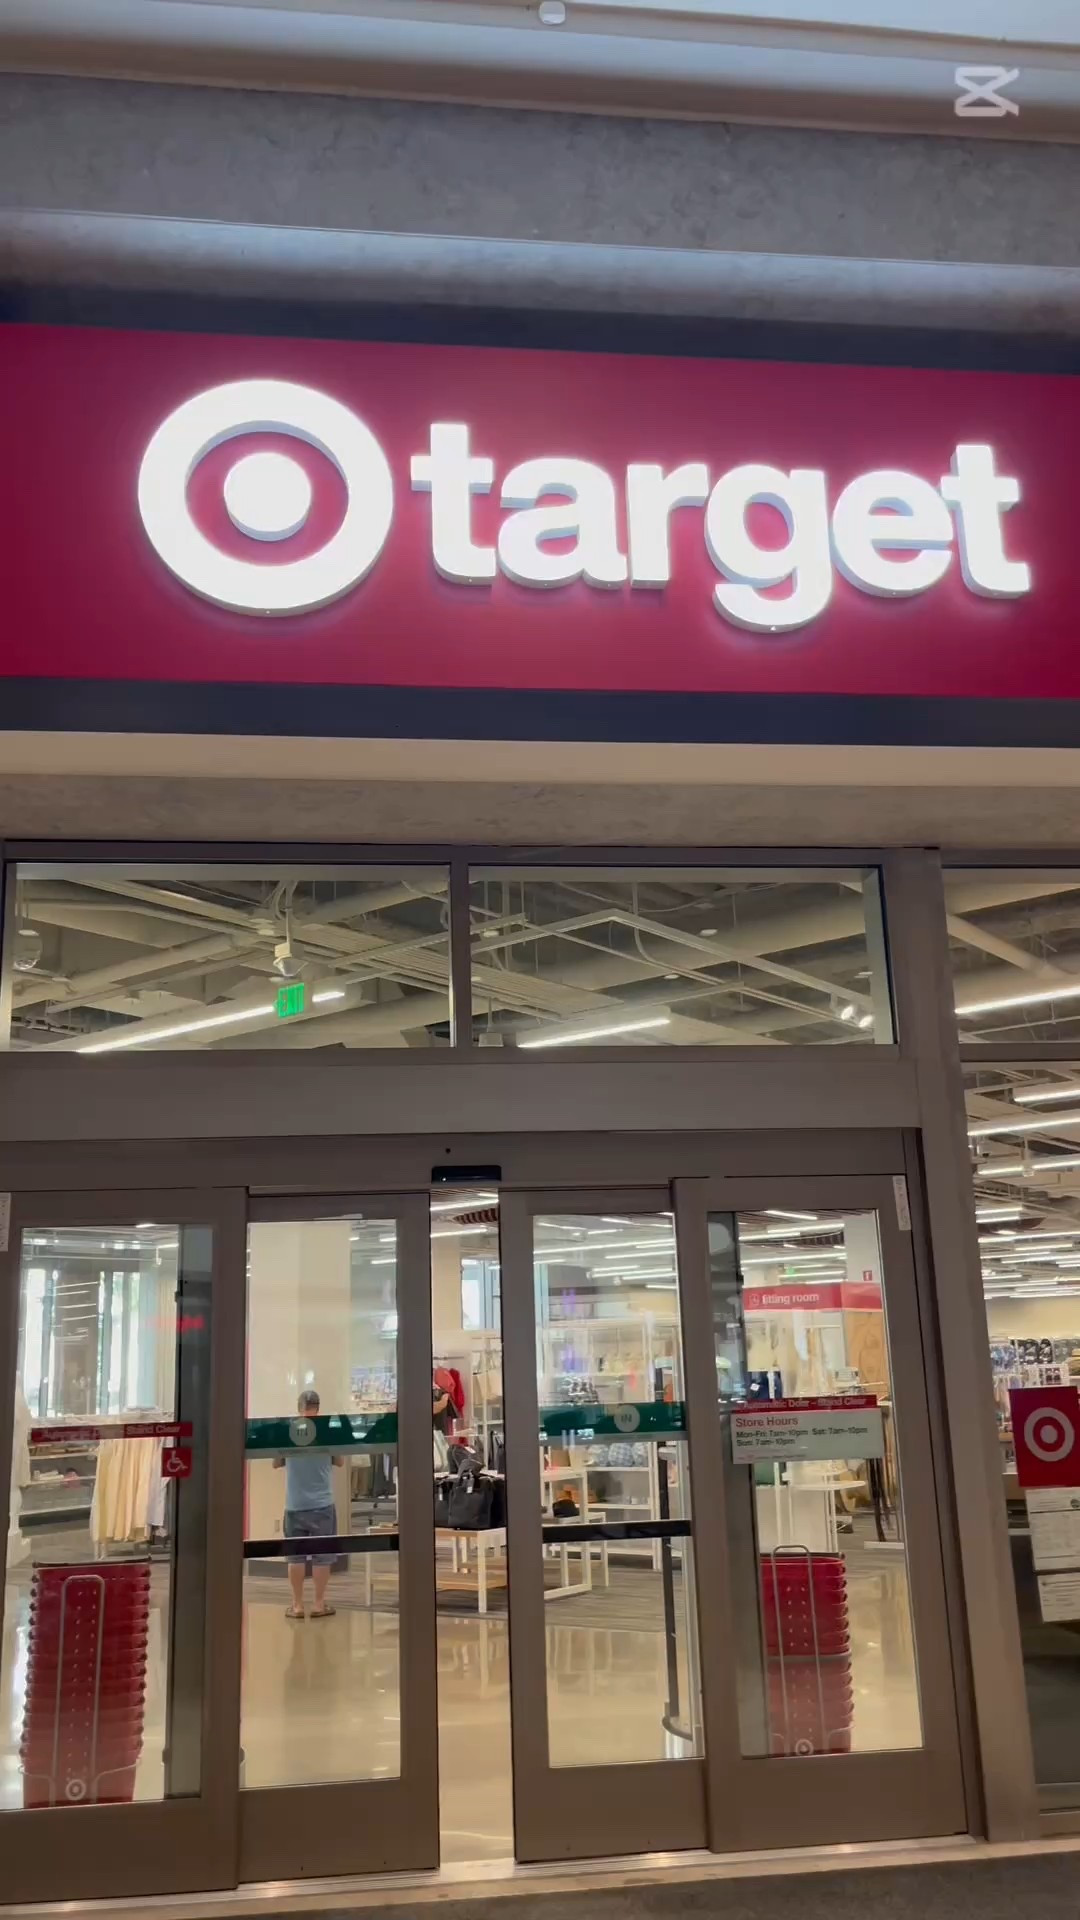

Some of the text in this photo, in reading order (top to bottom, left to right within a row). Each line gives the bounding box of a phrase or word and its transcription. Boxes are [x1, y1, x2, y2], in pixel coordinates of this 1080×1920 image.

[411, 424, 1030, 632] target
[762, 1293, 820, 1305] fitting room
[735, 1416, 799, 1428] Store Hours
